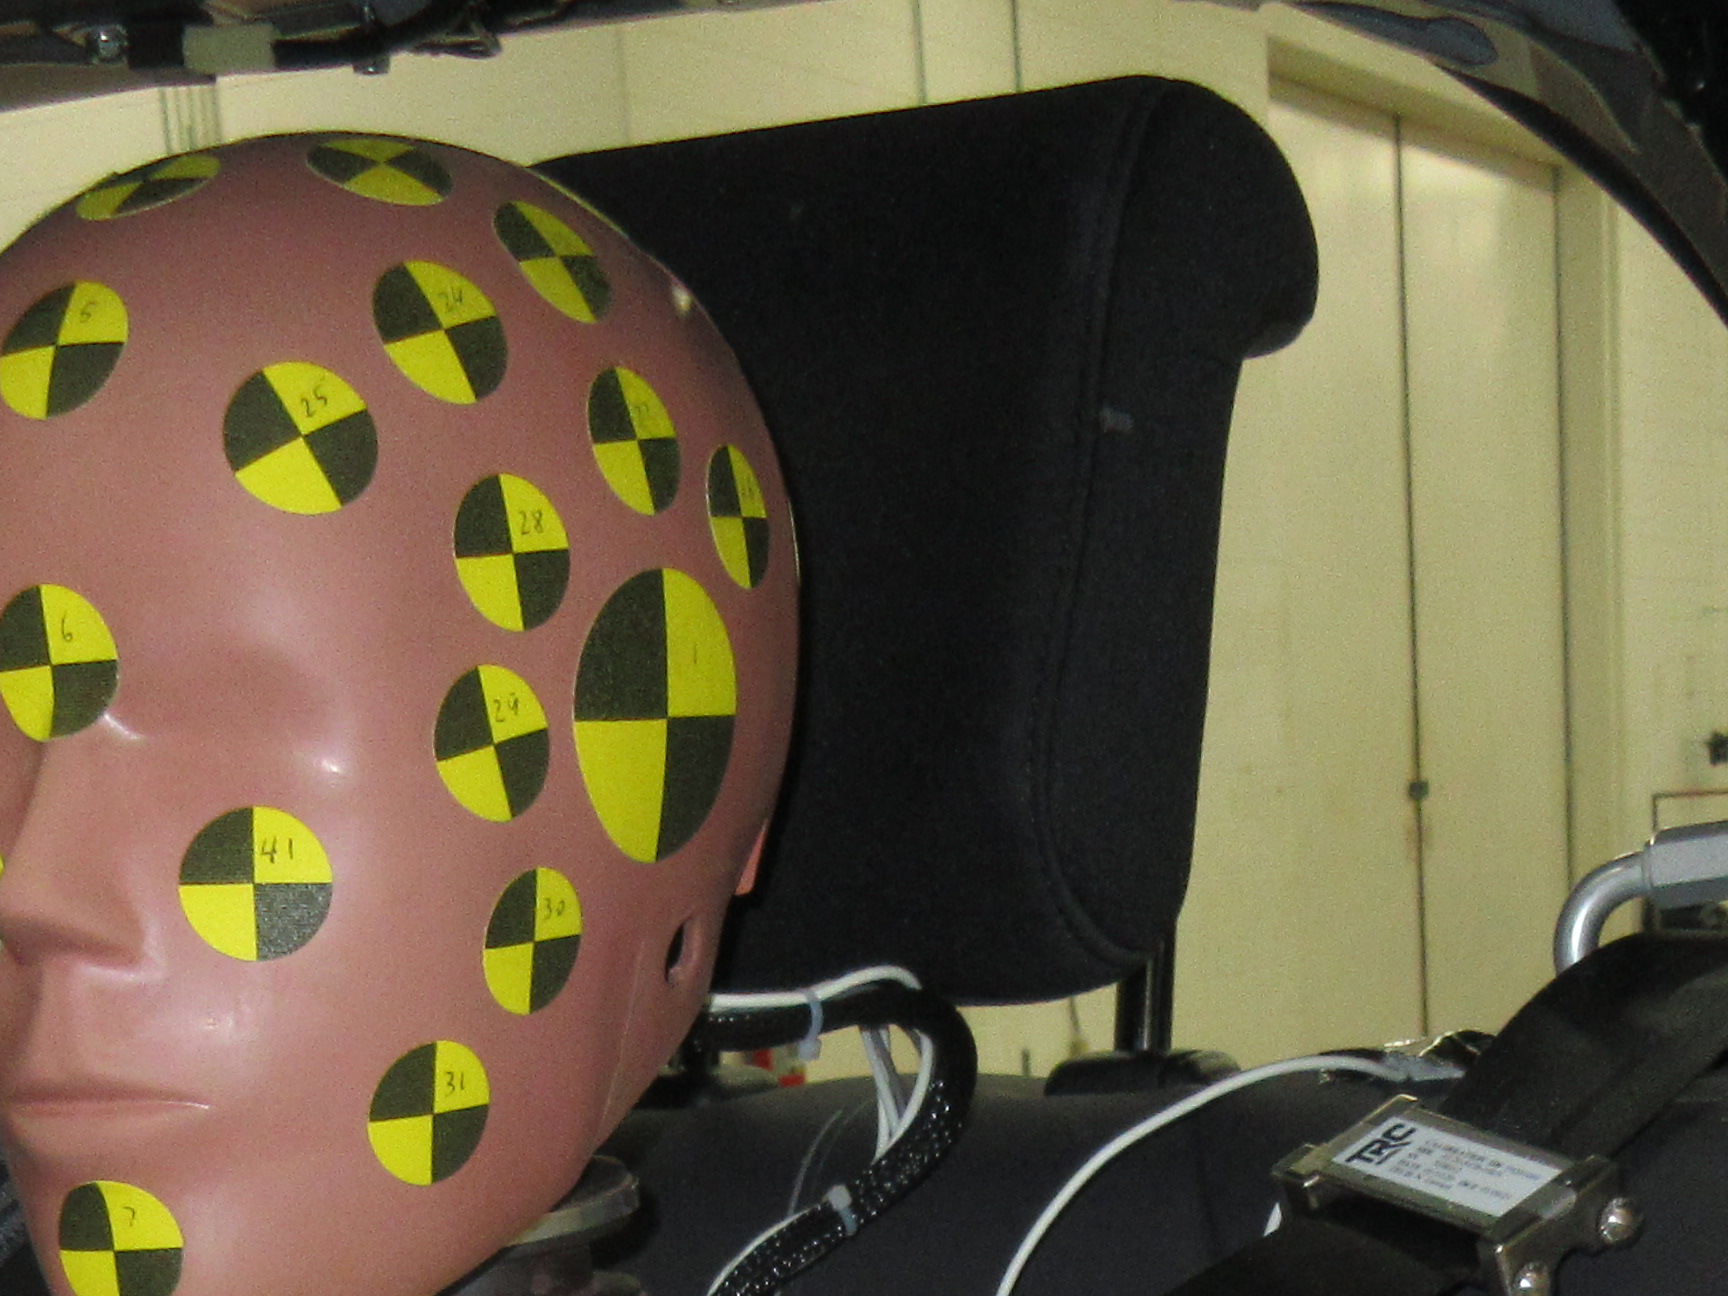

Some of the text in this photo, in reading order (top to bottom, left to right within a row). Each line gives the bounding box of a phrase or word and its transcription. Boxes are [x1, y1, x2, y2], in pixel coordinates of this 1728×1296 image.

[301, 375, 328, 418] 25
[518, 509, 543, 535] 28
[61, 609, 73, 642] 6
[259, 836, 293, 864] 41
[541, 897, 566, 920] 30
[444, 1070, 465, 1099] 31
[1345, 1122, 1417, 1166] TRC
[122, 1204, 136, 1227] 7
